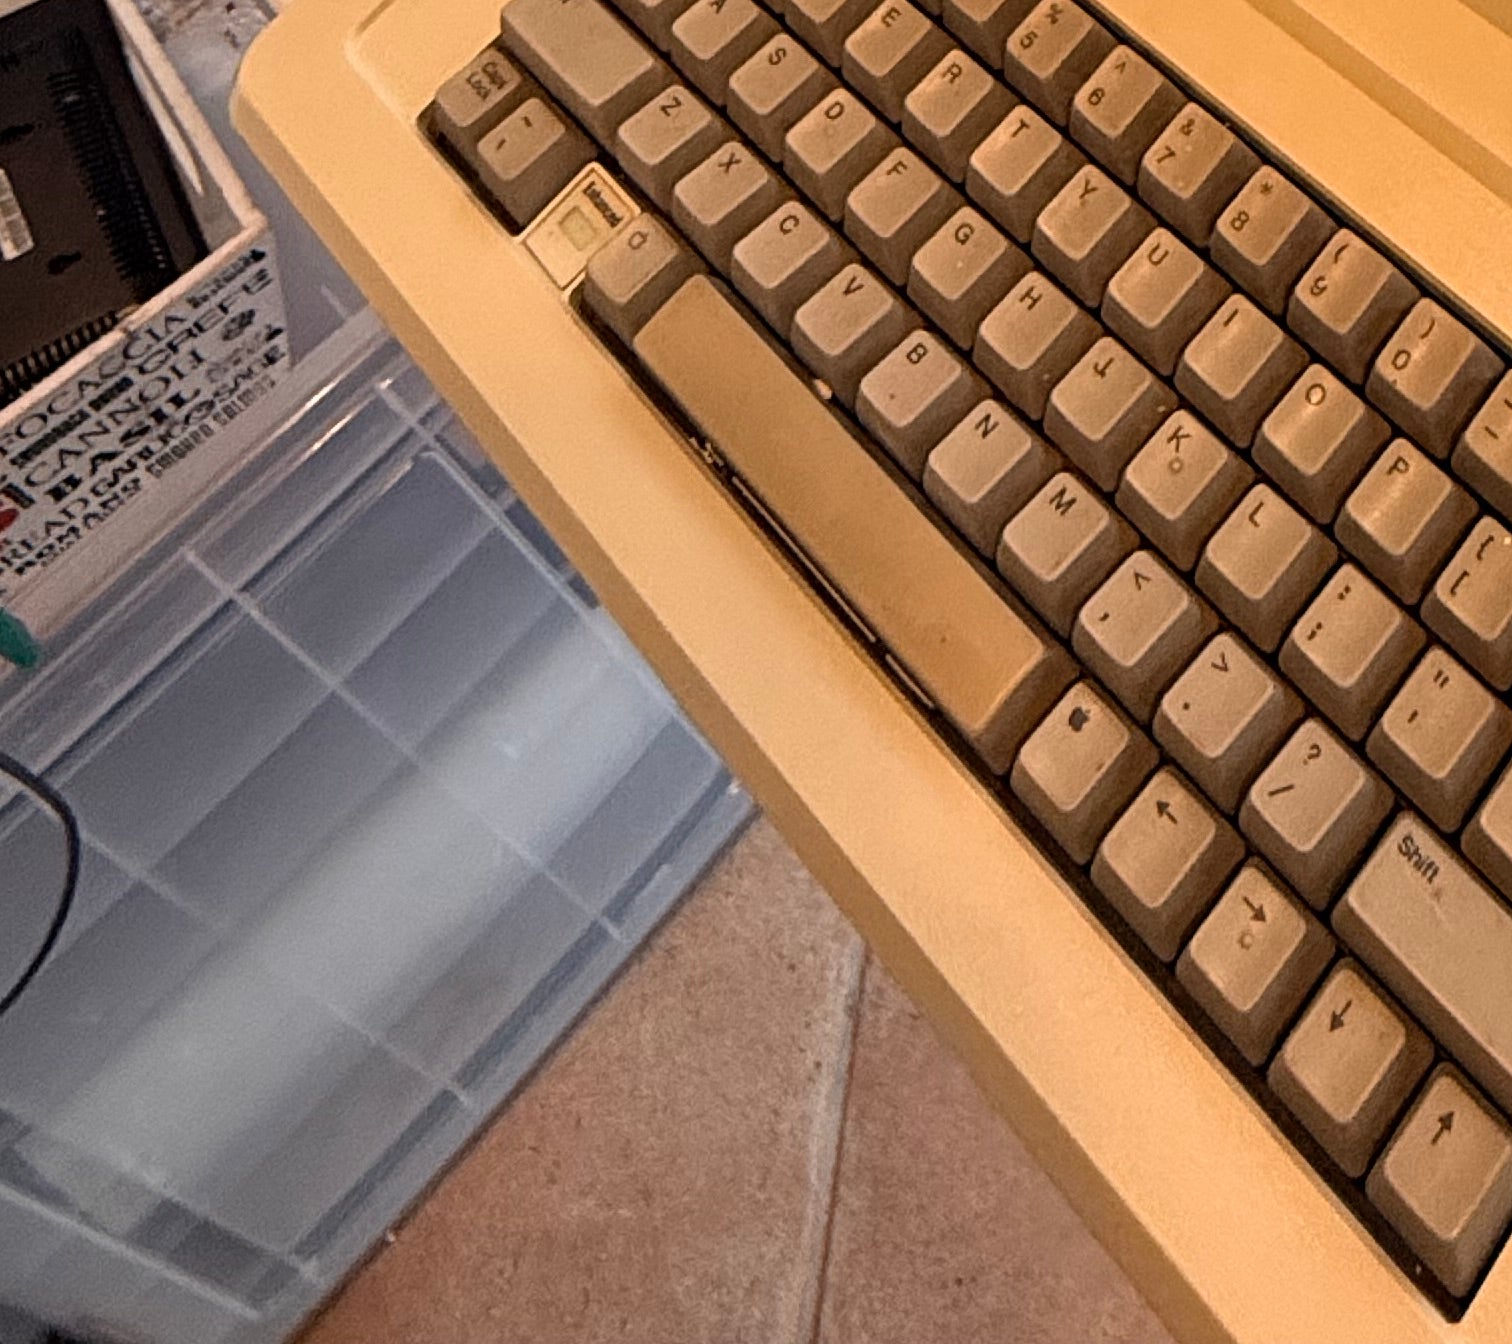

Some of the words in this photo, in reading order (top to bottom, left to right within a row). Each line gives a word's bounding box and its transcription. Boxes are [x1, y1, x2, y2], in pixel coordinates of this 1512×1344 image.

[881, 6, 902, 28] E
[1019, 31, 1038, 50] 5
[768, 47, 787, 66] S
[942, 62, 963, 84] R
[659, 96, 682, 117] Z
[1087, 87, 1106, 106] 6
[824, 100, 844, 120] D
[1010, 118, 1031, 138] T
[717, 152, 742, 174] X
[1156, 146, 1176, 165] 7
[886, 160, 908, 179] F
[1078, 178, 1099, 201] Y
[778, 213, 800, 236] C
[1230, 210, 1250, 232] 8
[954, 222, 975, 245] G
[1148, 243, 1169, 267] U
[842, 275, 864, 297] V
[1310, 275, 1328, 298] 9
[1019, 285, 1043, 311] H
[906, 342, 929, 365] B
[1093, 357, 1115, 379] J
[0, 315, 187, 456] FOCACCIA
[1304, 383, 1327, 406] O
[25, 349, 204, 487] CANNOLI
[974, 413, 999, 440] N
[45, 388, 201, 501] BASIL
[1166, 425, 1192, 453] K
[1386, 455, 1411, 477] P
[1049, 486, 1078, 517] M
[1248, 501, 1265, 528] L
[1302, 743, 1322, 766] ?
[1397, 834, 1440, 885] Shift
